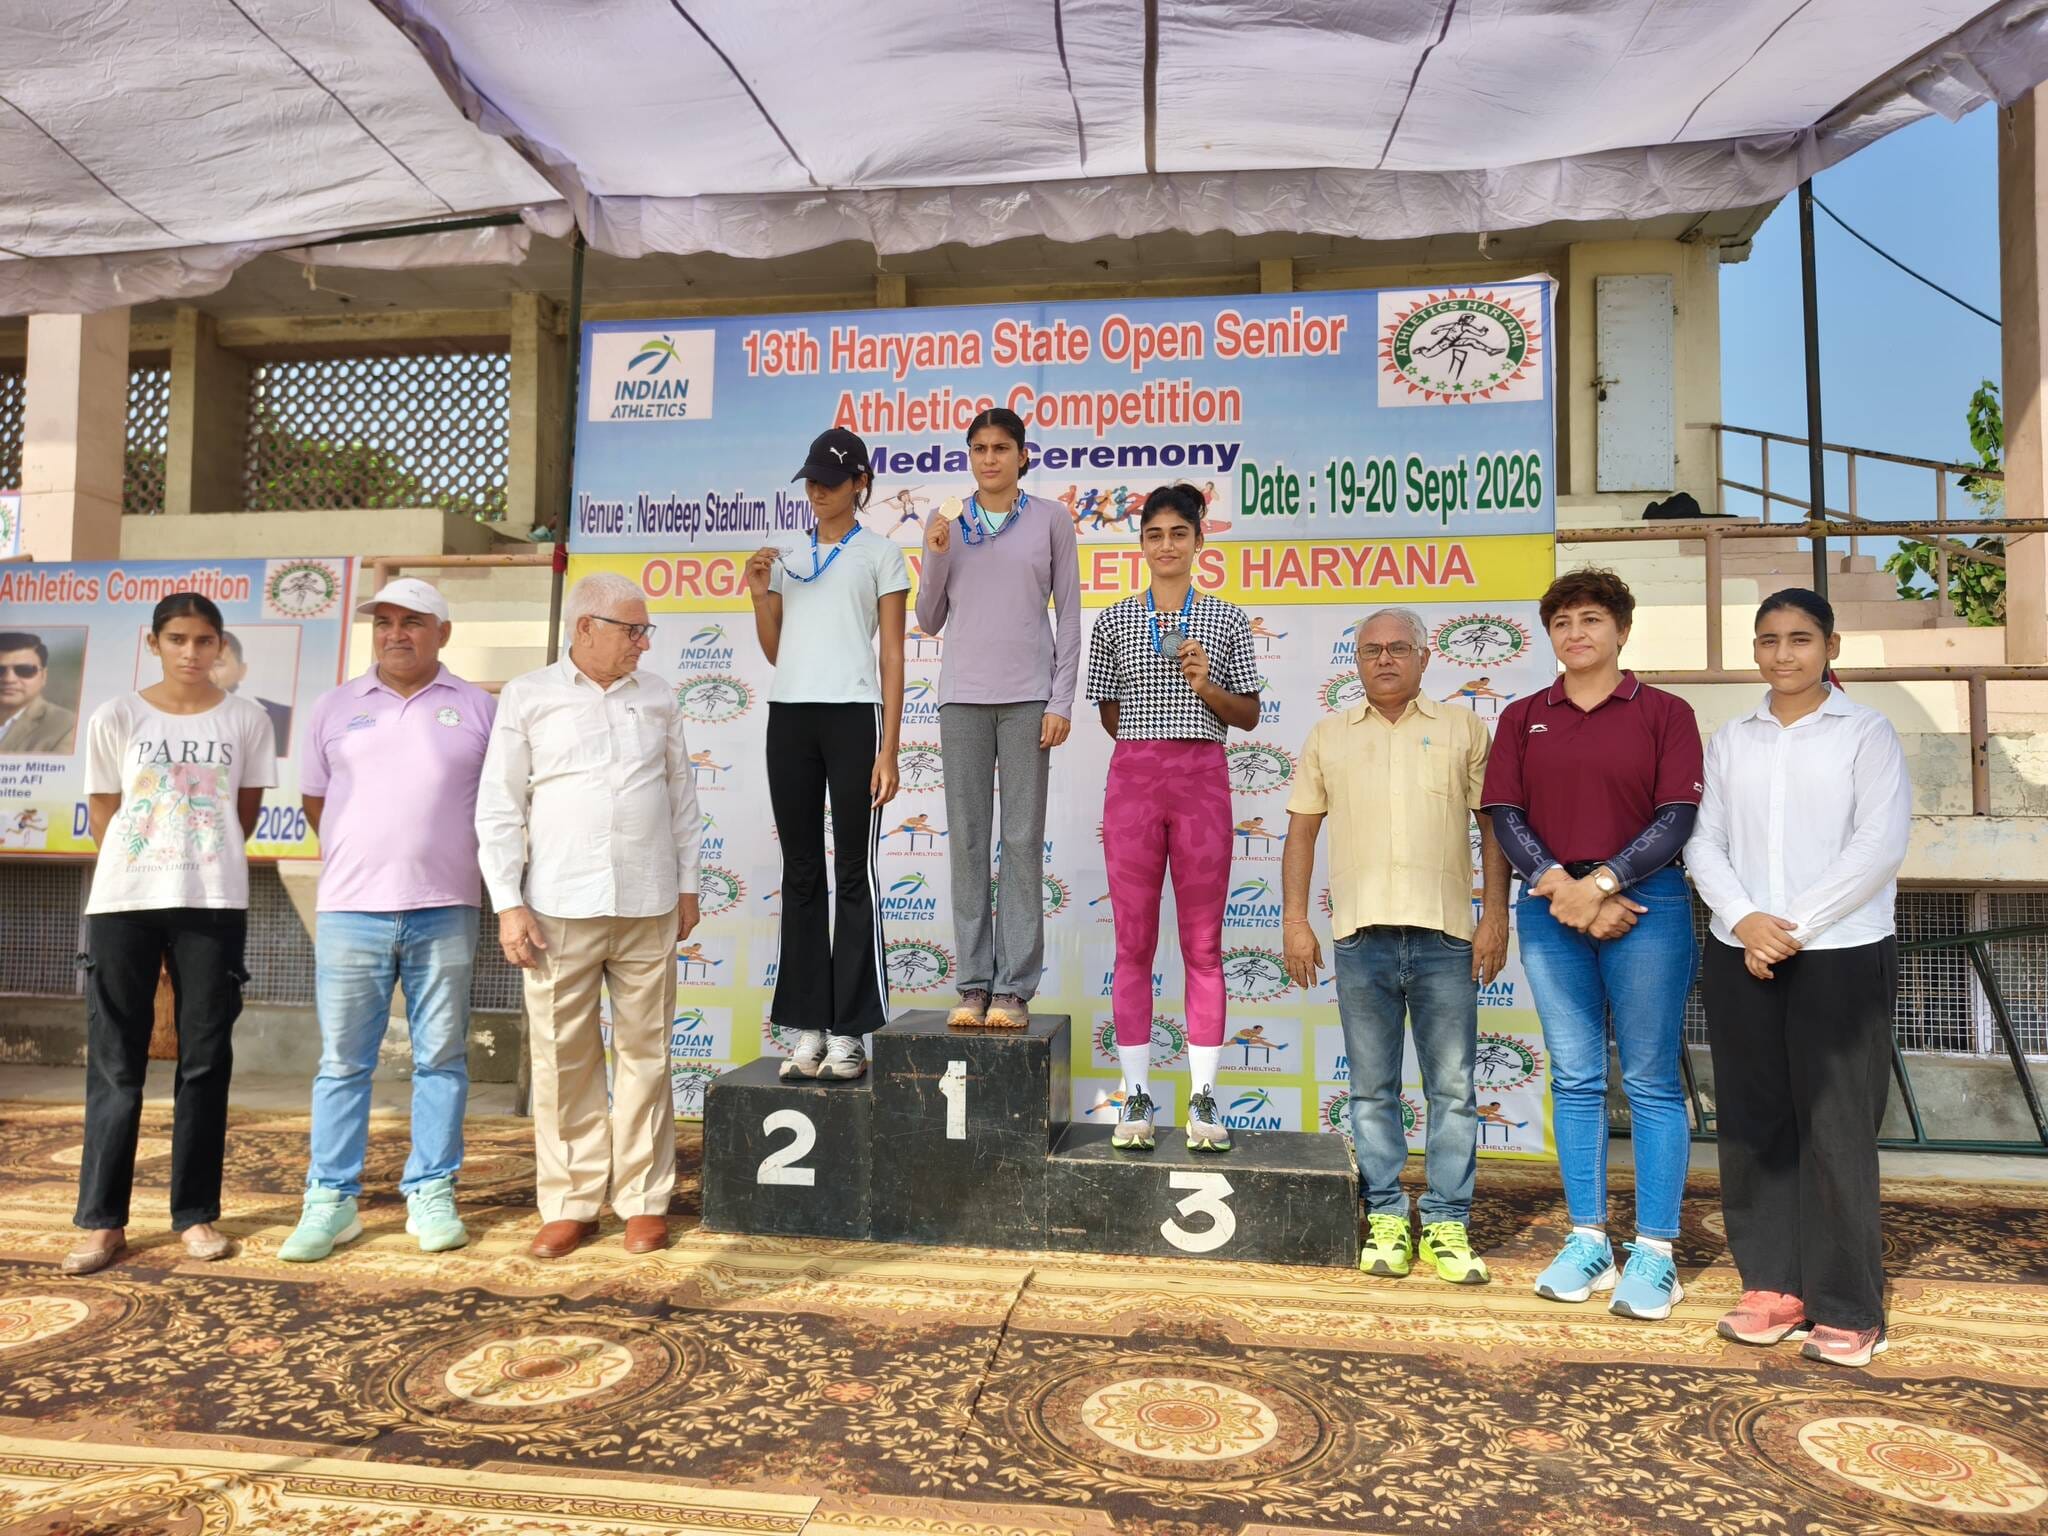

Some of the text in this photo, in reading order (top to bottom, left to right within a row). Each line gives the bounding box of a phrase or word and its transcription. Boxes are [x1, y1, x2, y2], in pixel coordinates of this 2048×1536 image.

[1397, 301, 1523, 357] ATHLETICS HARYANA
[745, 309, 1346, 379] 13th Haryana State Open Senior
[614, 379, 689, 400] INDIAN
[610, 402, 686, 418] ATHLETICS
[1008, 383, 1241, 435] Competition
[869, 445, 968, 474] Meda
[1241, 454, 1542, 526] Date : 19-20 Sept 2026
[579, 495, 624, 534] Venue
[637, 494, 700, 542] Navdeep
[705, 492, 770, 538] Stadium,
[775, 491, 819, 530] Narw
[1241, 545, 1475, 591] HARYANA
[0, 571, 99, 601] Athletics
[678, 661, 732, 669] ATHLETICS
[681, 648, 733, 660] INDIAN
[904, 702, 939, 714] DIAN
[137, 738, 233, 766] PARIS
[256, 806, 306, 840] 2026
[1620, 810, 1677, 862] PORTS
[881, 897, 936, 910] INDIAN
[1226, 904, 1281, 917] NDIAN
[1477, 996, 1513, 1007] ETICS
[671, 1034, 714, 1047] DIAN
[671, 1048, 712, 1057] HLETICS
[940, 1061, 967, 1139] 1
[1221, 1115, 1282, 1130] INDIAN
[757, 1109, 816, 1187] 2
[1160, 1171, 1237, 1253] 3
